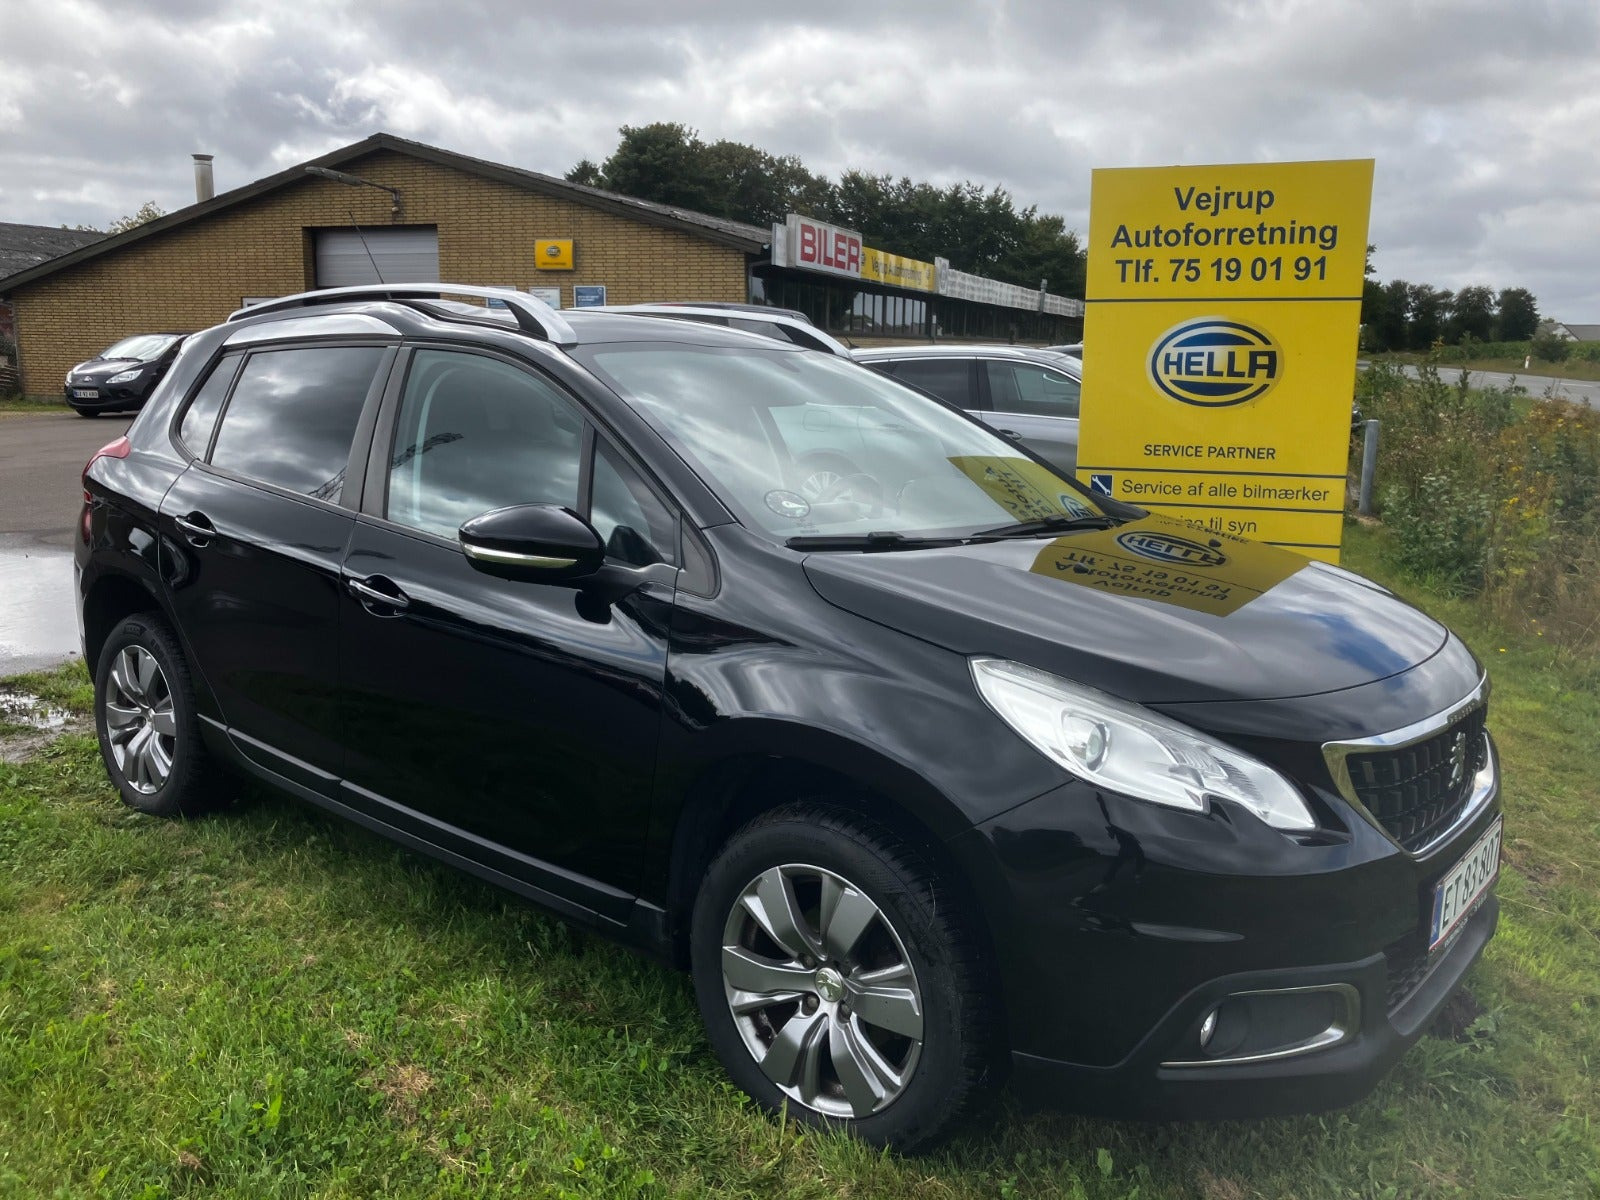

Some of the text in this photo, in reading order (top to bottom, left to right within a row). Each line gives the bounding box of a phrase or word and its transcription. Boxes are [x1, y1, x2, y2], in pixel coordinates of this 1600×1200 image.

[1174, 186, 1275, 216] Vejrup
[801, 223, 860, 273] BILER
[1110, 220, 1338, 251] Autoforretning
[1115, 255, 1327, 283] Tlf. 75 19 01 91
[1163, 350, 1277, 379] HELLA
[1143, 444, 1276, 460] SERVICE PARTNER
[1121, 479, 1330, 501] Service af alle bilmærker
[1209, 517, 1222, 531] til
[1227, 520, 1257, 536] syn
[1442, 872, 1463, 929] ET
[1462, 856, 1478, 905] 83
[1479, 829, 1500, 885] 807
